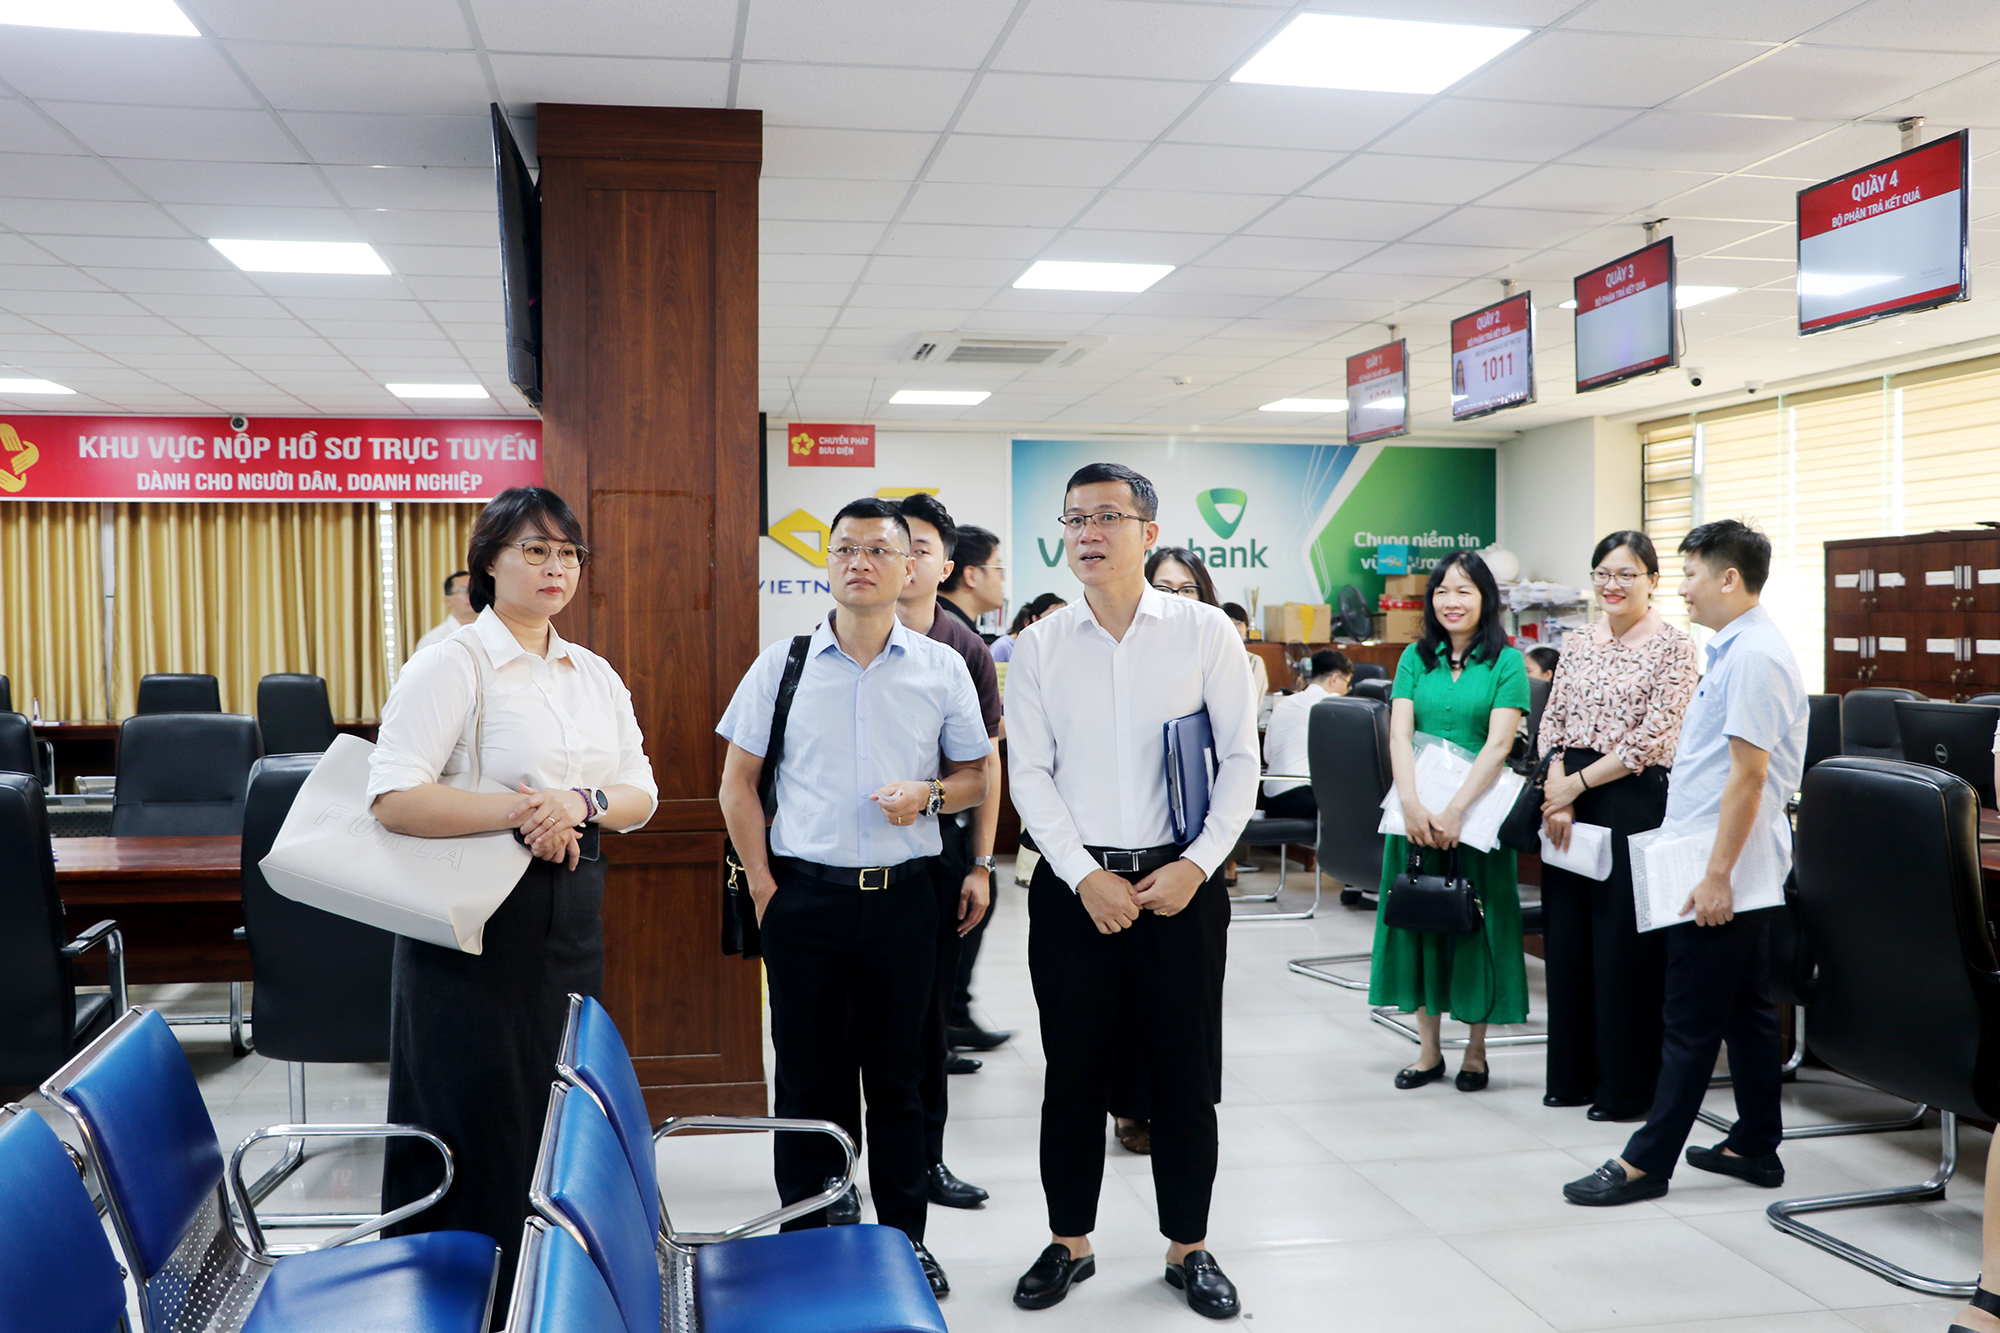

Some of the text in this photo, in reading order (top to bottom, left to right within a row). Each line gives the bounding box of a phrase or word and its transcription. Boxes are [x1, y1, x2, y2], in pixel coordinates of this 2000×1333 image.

[1852, 170, 1899, 201] QUẦY 4
[1832, 187, 1921, 227] BỘ PHẬN TRẢ KẾT QUẢ
[1605, 264, 1634, 288] QUẦY 3
[1476, 310, 1500, 331] QUẦY 2
[1482, 352, 1513, 383] 1011
[79, 431, 537, 464] KHU VỰC NỘP HỒ SƠ TRỰC TUYẾN
[850, 436, 869, 445] PHÁT
[137, 469, 483, 494] DÀNH CHO NGƯỜI DÂN, DOANH NGHIỆP
[1412, 530, 1455, 547] niềm
[1457, 533, 1480, 547] tin
